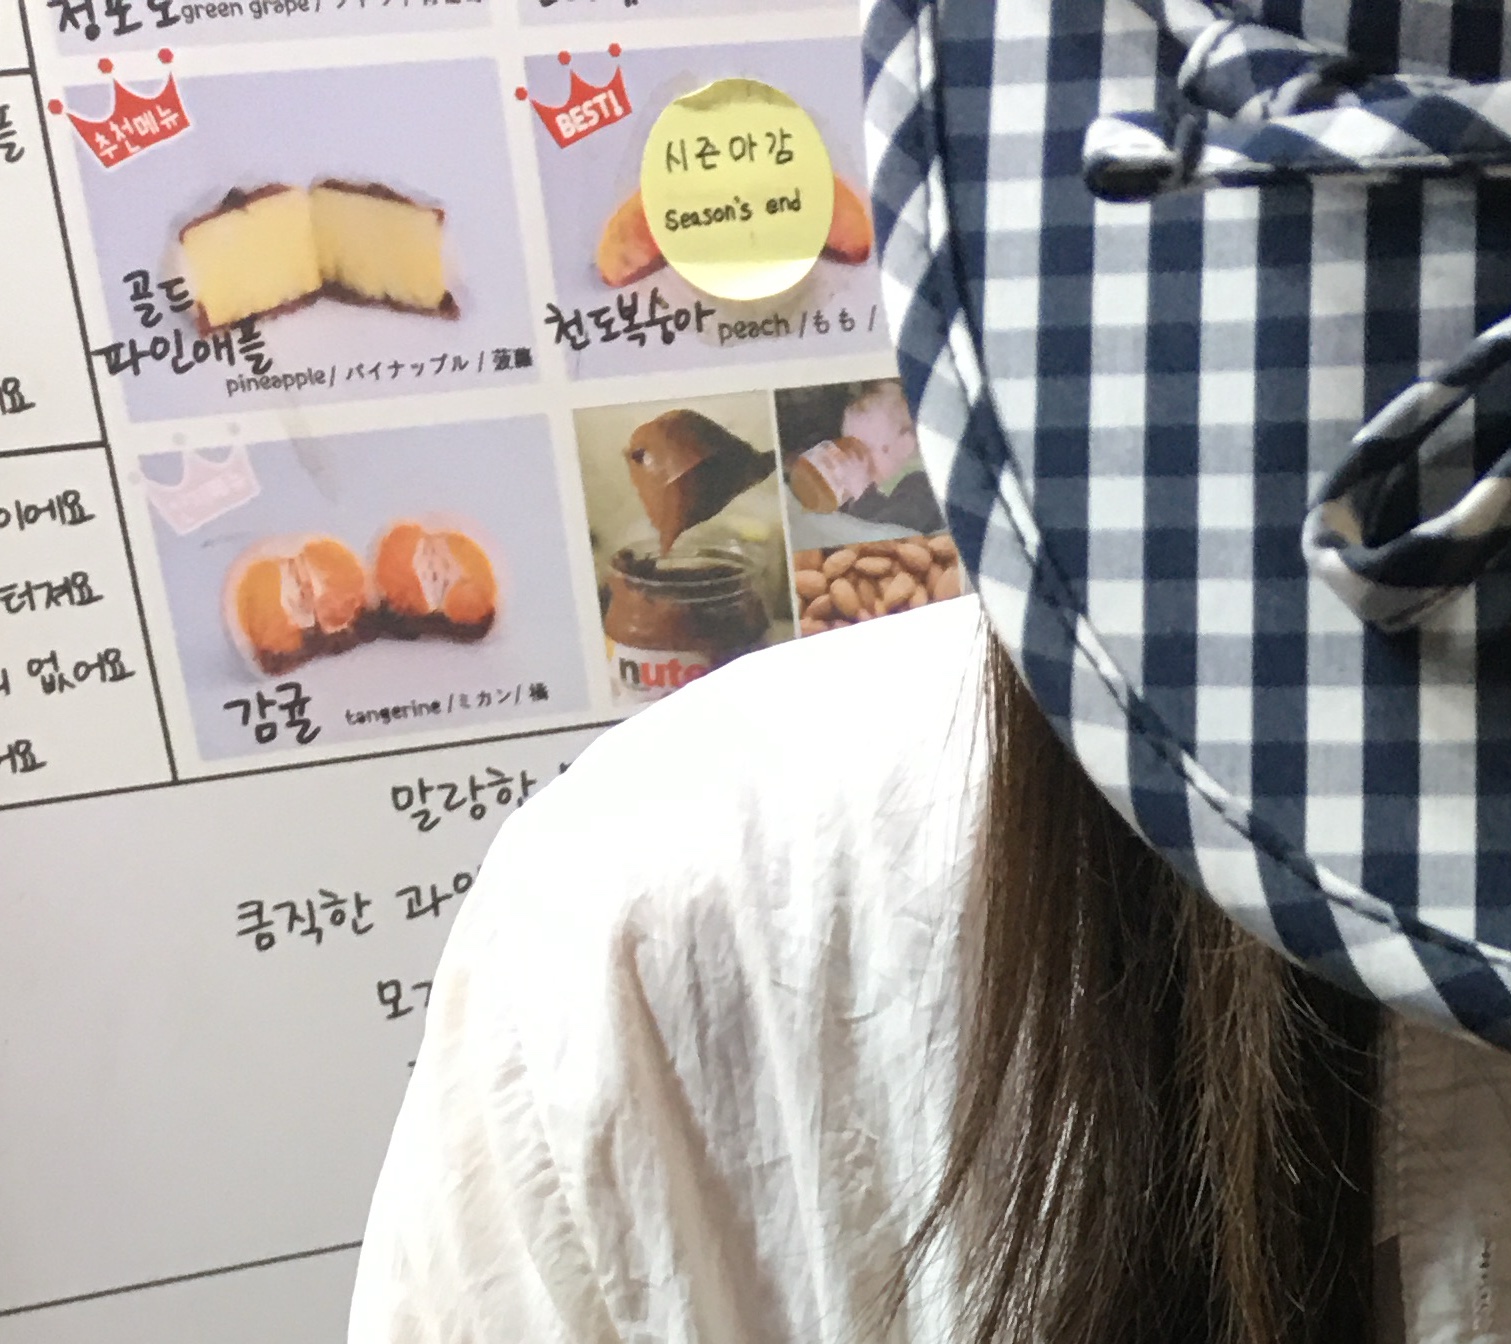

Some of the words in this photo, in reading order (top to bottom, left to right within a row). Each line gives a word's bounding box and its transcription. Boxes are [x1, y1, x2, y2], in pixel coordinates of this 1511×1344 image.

[180, 0, 244, 24] green
[95, 104, 180, 159] 추천메뉴
[555, 89, 624, 138] BEST!
[664, 195, 753, 232] Season's
[765, 186, 802, 215] end
[122, 269, 194, 328] 골드
[544, 286, 716, 351] 천도복숭아
[90, 313, 273, 376] 파인애플
[717, 312, 791, 347] peach
[0, 376, 37, 416] 요
[26, 647, 137, 696] 없어요
[223, 681, 321, 745] 감귤
[345, 700, 442, 726] tangerine
[390, 765, 538, 833] 말랑한
[236, 887, 375, 952] 큼직한
